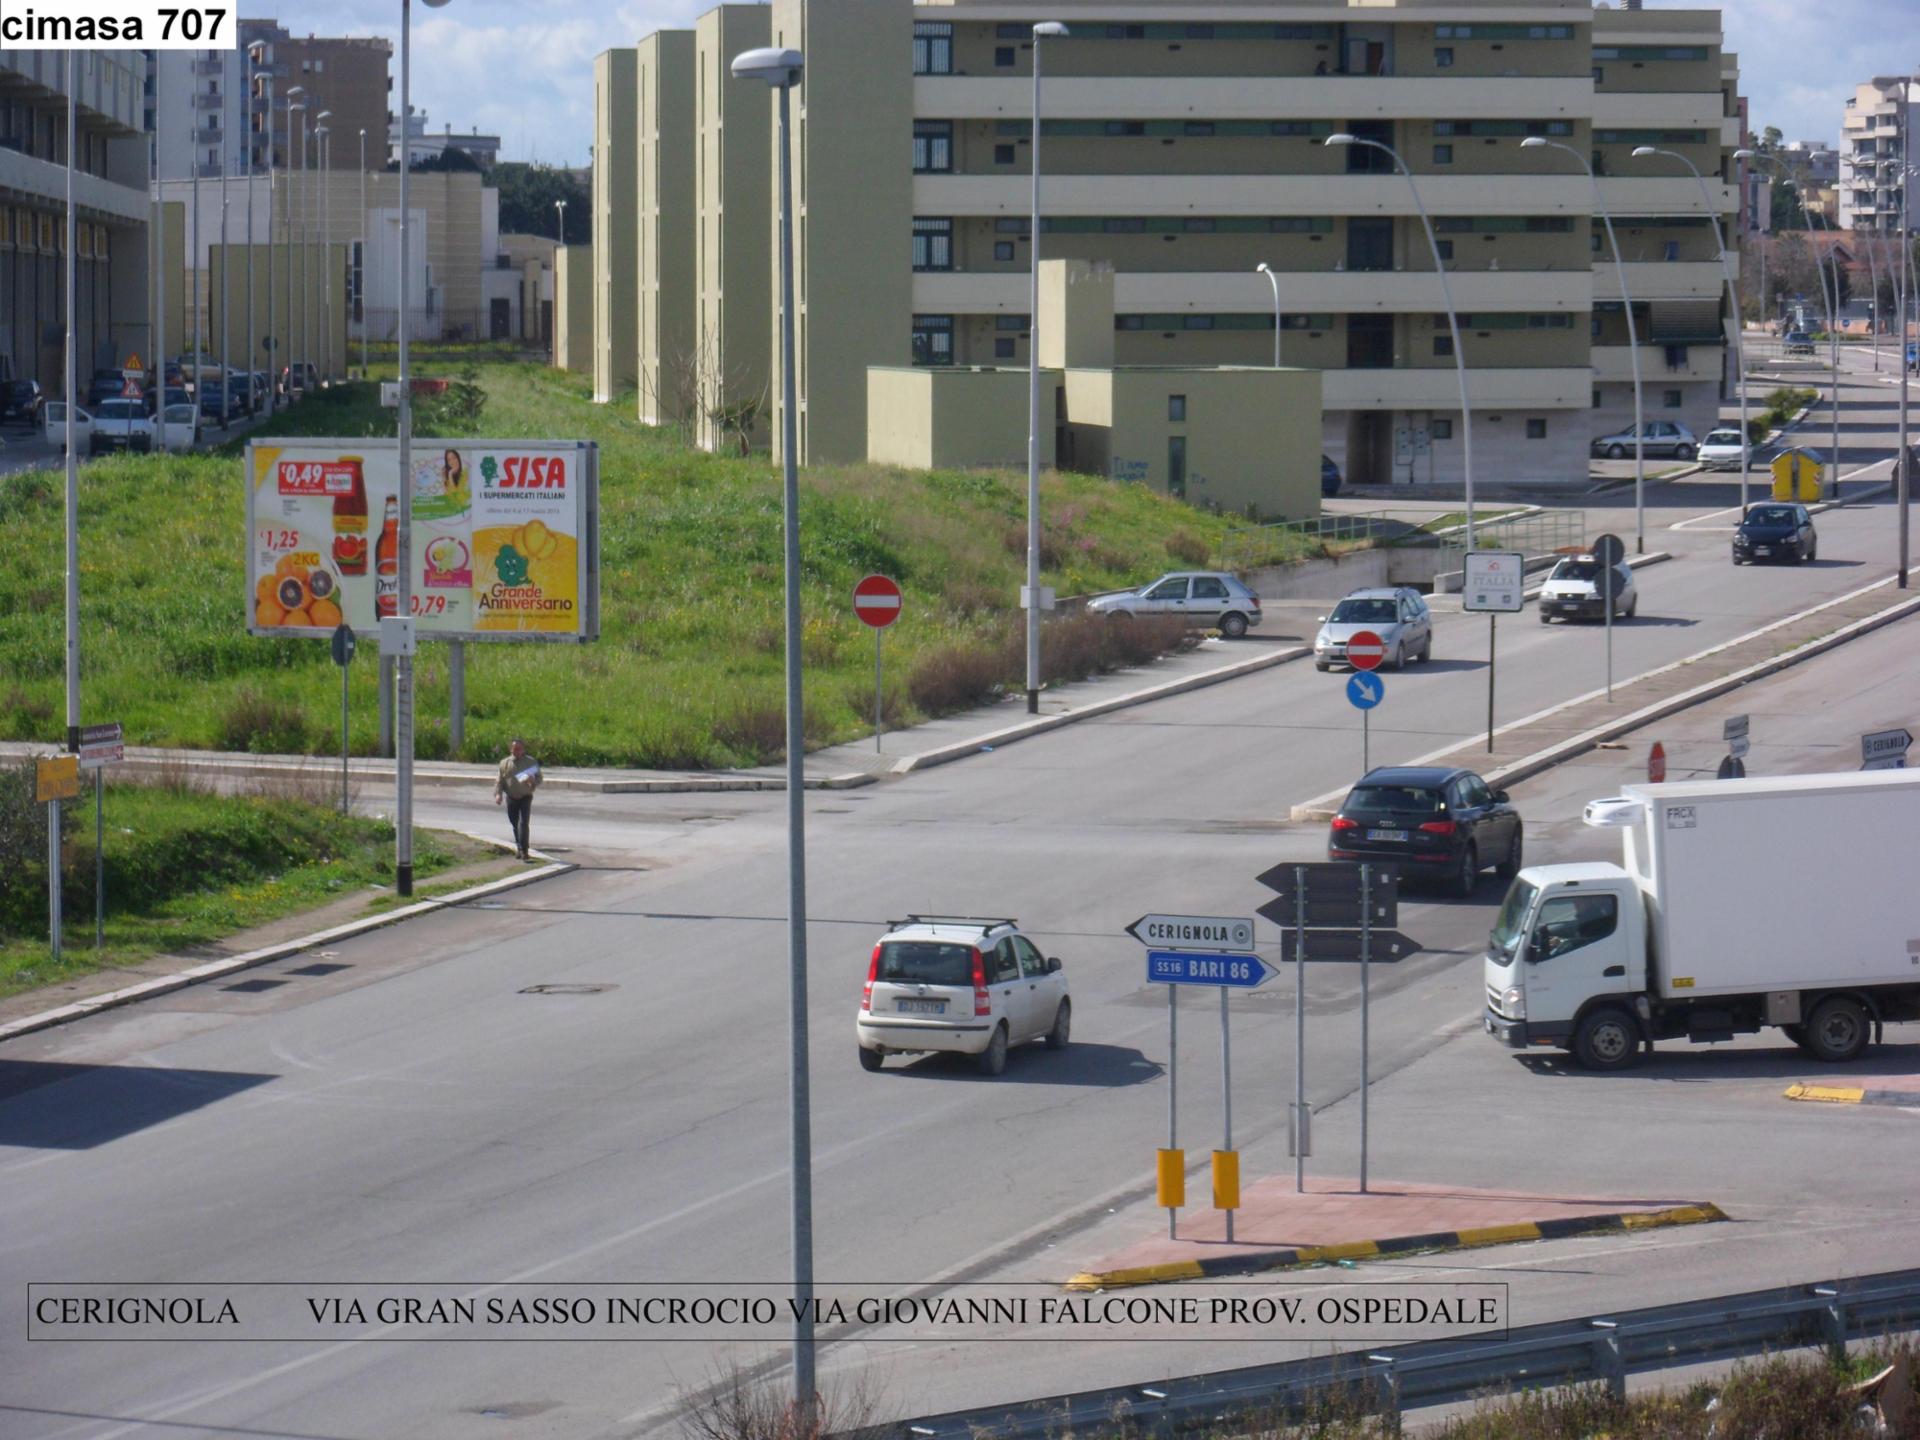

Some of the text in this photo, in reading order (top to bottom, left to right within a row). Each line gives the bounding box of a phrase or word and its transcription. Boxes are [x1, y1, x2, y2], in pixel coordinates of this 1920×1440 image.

[499, 457, 565, 488] SISA
[484, 492, 535, 500] SUPERMERCATI
[536, 492, 566, 500] ITALIANI
[294, 554, 320, 566] 2KG
[491, 583, 543, 598] Grande
[479, 593, 573, 611] Anniversario
[1148, 923, 1229, 941] CERIGNOLA
[1188, 960, 1225, 978] BARI
[1230, 962, 1250, 980] 86
